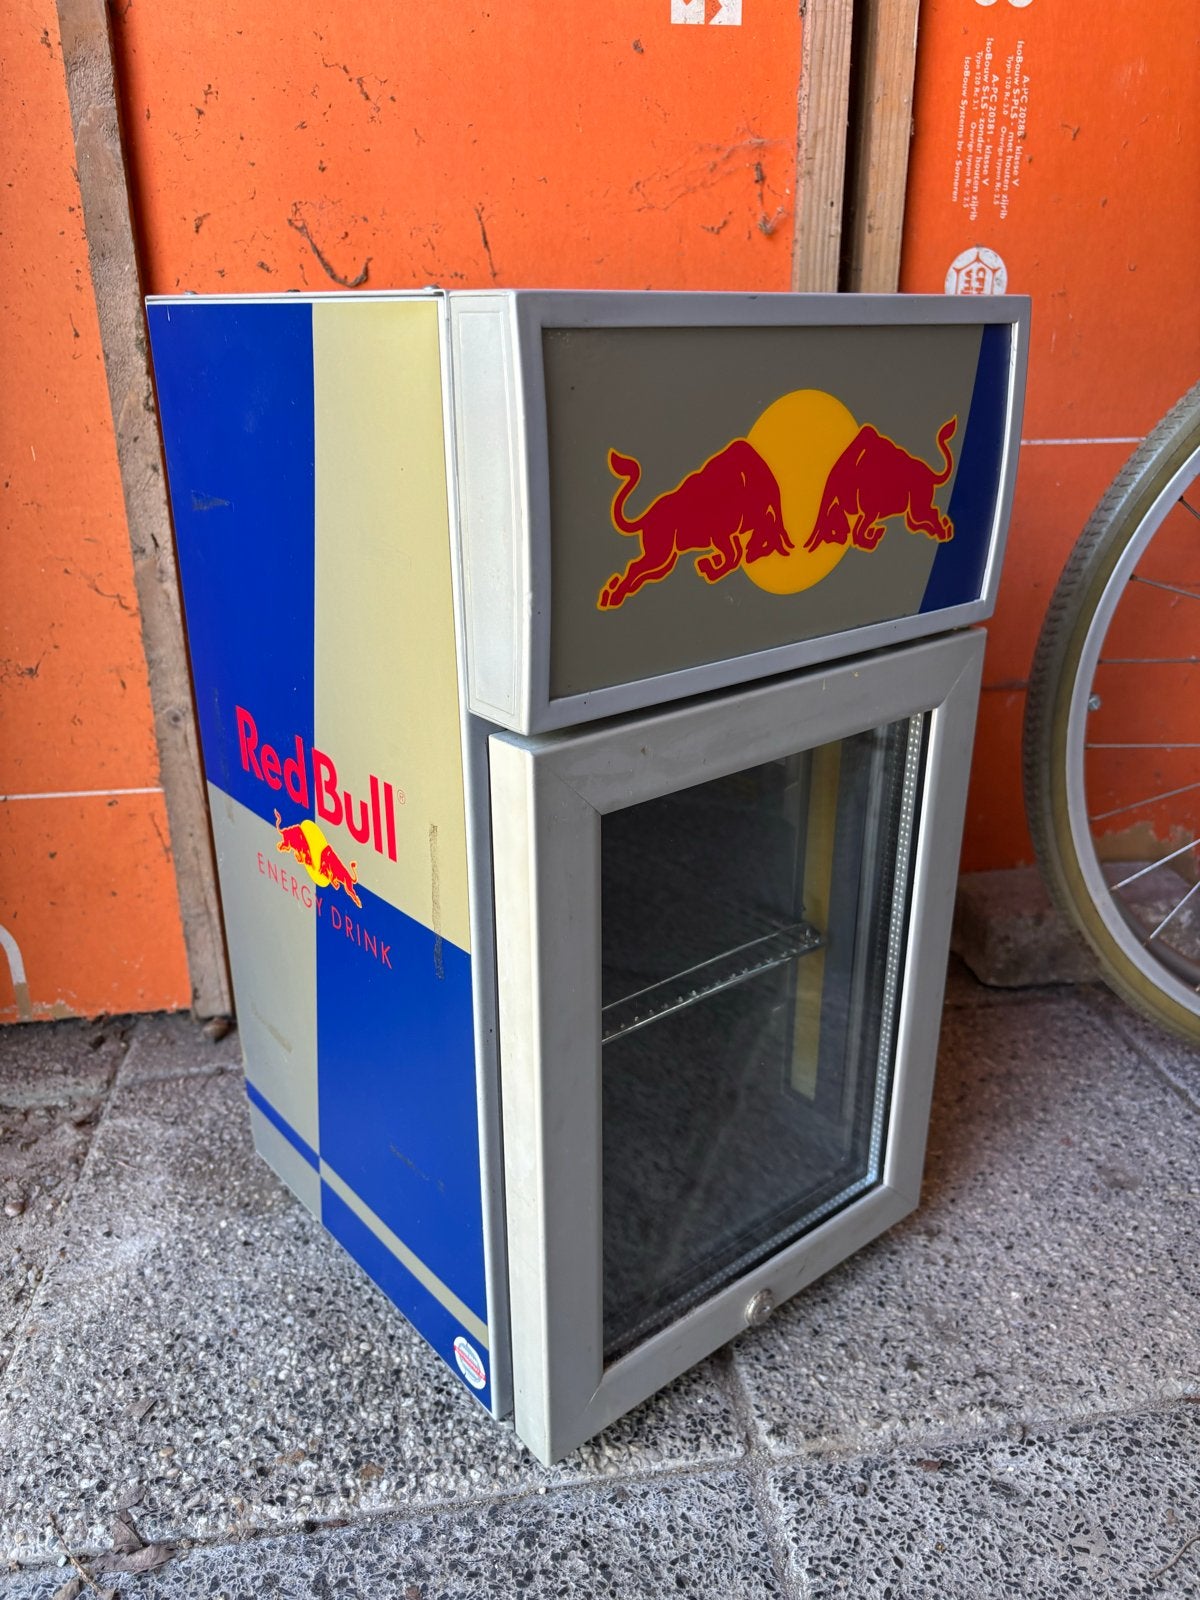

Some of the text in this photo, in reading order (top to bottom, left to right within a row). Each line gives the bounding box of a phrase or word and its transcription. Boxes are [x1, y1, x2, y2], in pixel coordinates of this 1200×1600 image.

[975, 51, 983, 69] Type
[983, 38, 994, 82] IsoBouw
[1006, 56, 1014, 73] Type
[1014, 41, 1025, 85] IsoBouw
[962, 57, 971, 96] IsoBouw
[990, 75, 999, 102] A-PC
[1020, 75, 1030, 103] A-PC
[981, 86, 989, 109] S-LS
[1010, 89, 1020, 119] S-PLS
[957, 100, 968, 138] Systems
[987, 106, 996, 134] 20381
[957, 141, 964, 151] bv
[967, 122, 976, 152] Overige
[976, 118, 985, 153] zonder
[998, 126, 1007, 156] Overige
[973, 157, 982, 192] houten
[983, 145, 992, 175] klasse
[1003, 155, 1013, 191] houten
[1013, 146, 1023, 175] klasse
[952, 160, 962, 202] Someren
[969, 195, 978, 220] zijrib
[1000, 194, 1009, 219] zijrib
[235, 704, 398, 863] Red Bull
[256, 851, 393, 969] ENERGY DRINK
